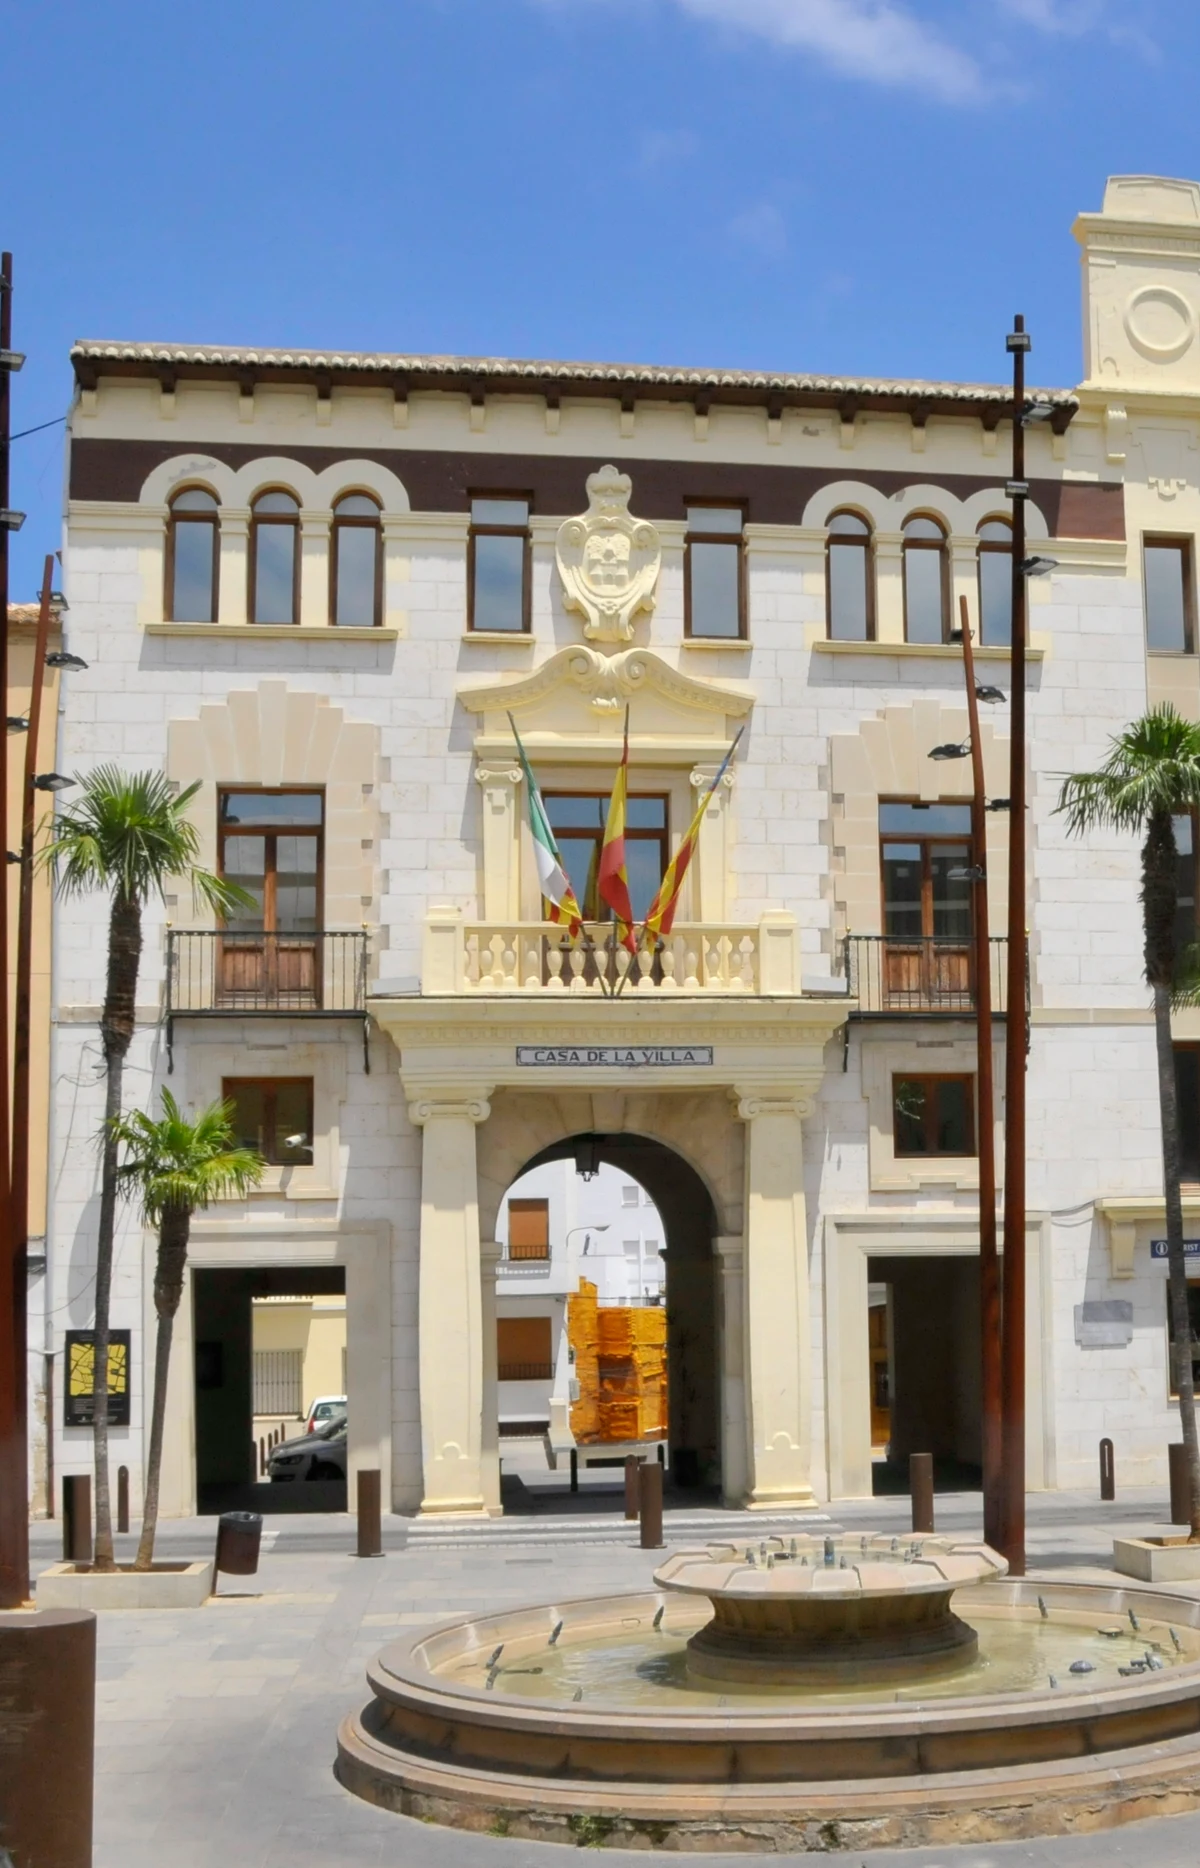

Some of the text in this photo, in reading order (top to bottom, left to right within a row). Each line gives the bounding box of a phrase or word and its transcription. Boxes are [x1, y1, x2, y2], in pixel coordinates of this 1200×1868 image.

[534, 1051, 696, 1062] CASA DE LA VILLA
